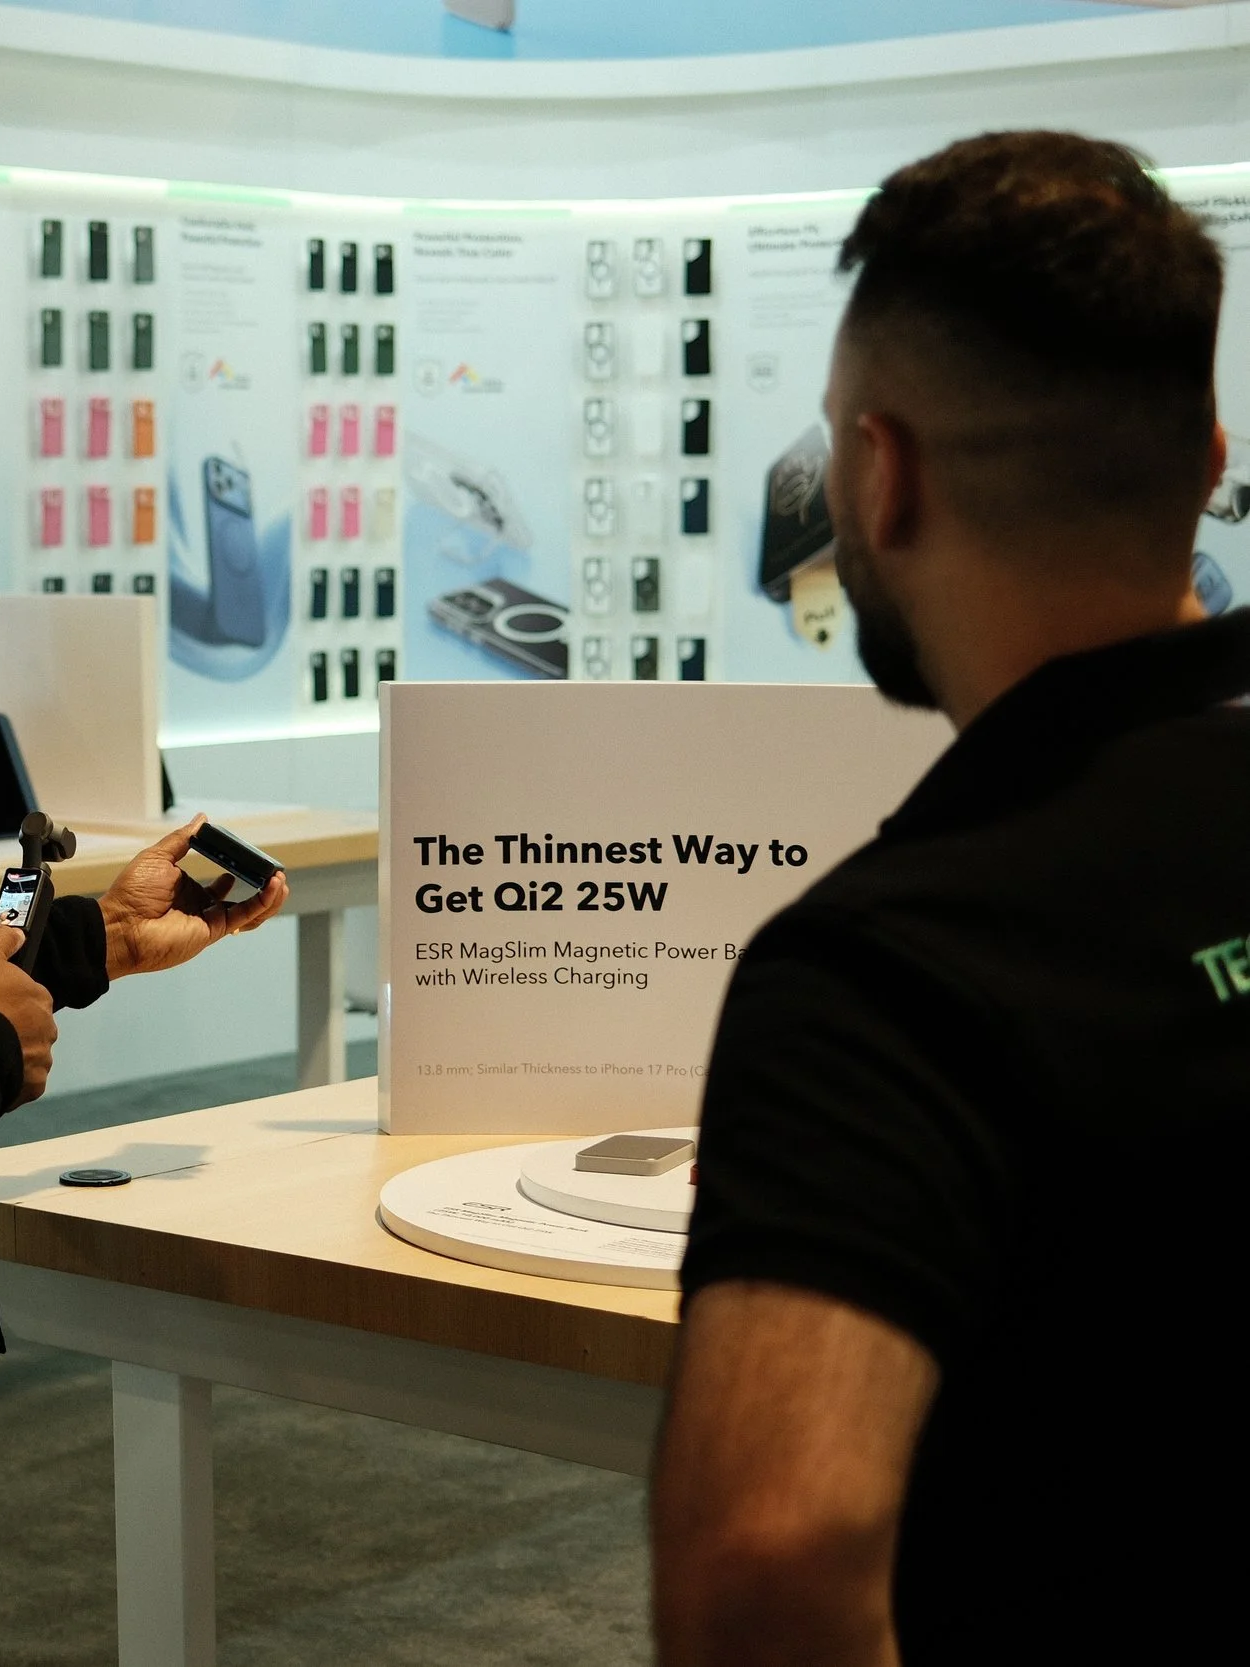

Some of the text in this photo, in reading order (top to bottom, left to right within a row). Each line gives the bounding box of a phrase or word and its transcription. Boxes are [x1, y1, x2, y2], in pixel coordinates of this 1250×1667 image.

[414, 833, 808, 875] The Thinnest Way to
[415, 881, 668, 913] Get Qi2 25W
[416, 940, 749, 963] ESR MagSlim Magnetic Power Ba
[415, 967, 649, 989] with Wireless Charging
[1191, 933, 1250, 1003] TE
[418, 1064, 443, 1076] 13.8
[477, 1063, 518, 1075] Similar
[521, 1063, 582, 1075] Thickness
[585, 1064, 598, 1074] to
[600, 1063, 644, 1075] iPhone
[648, 1064, 662, 1075] 17
[666, 1065, 687, 1076] Pro
[462, 1201, 513, 1212] ESR
